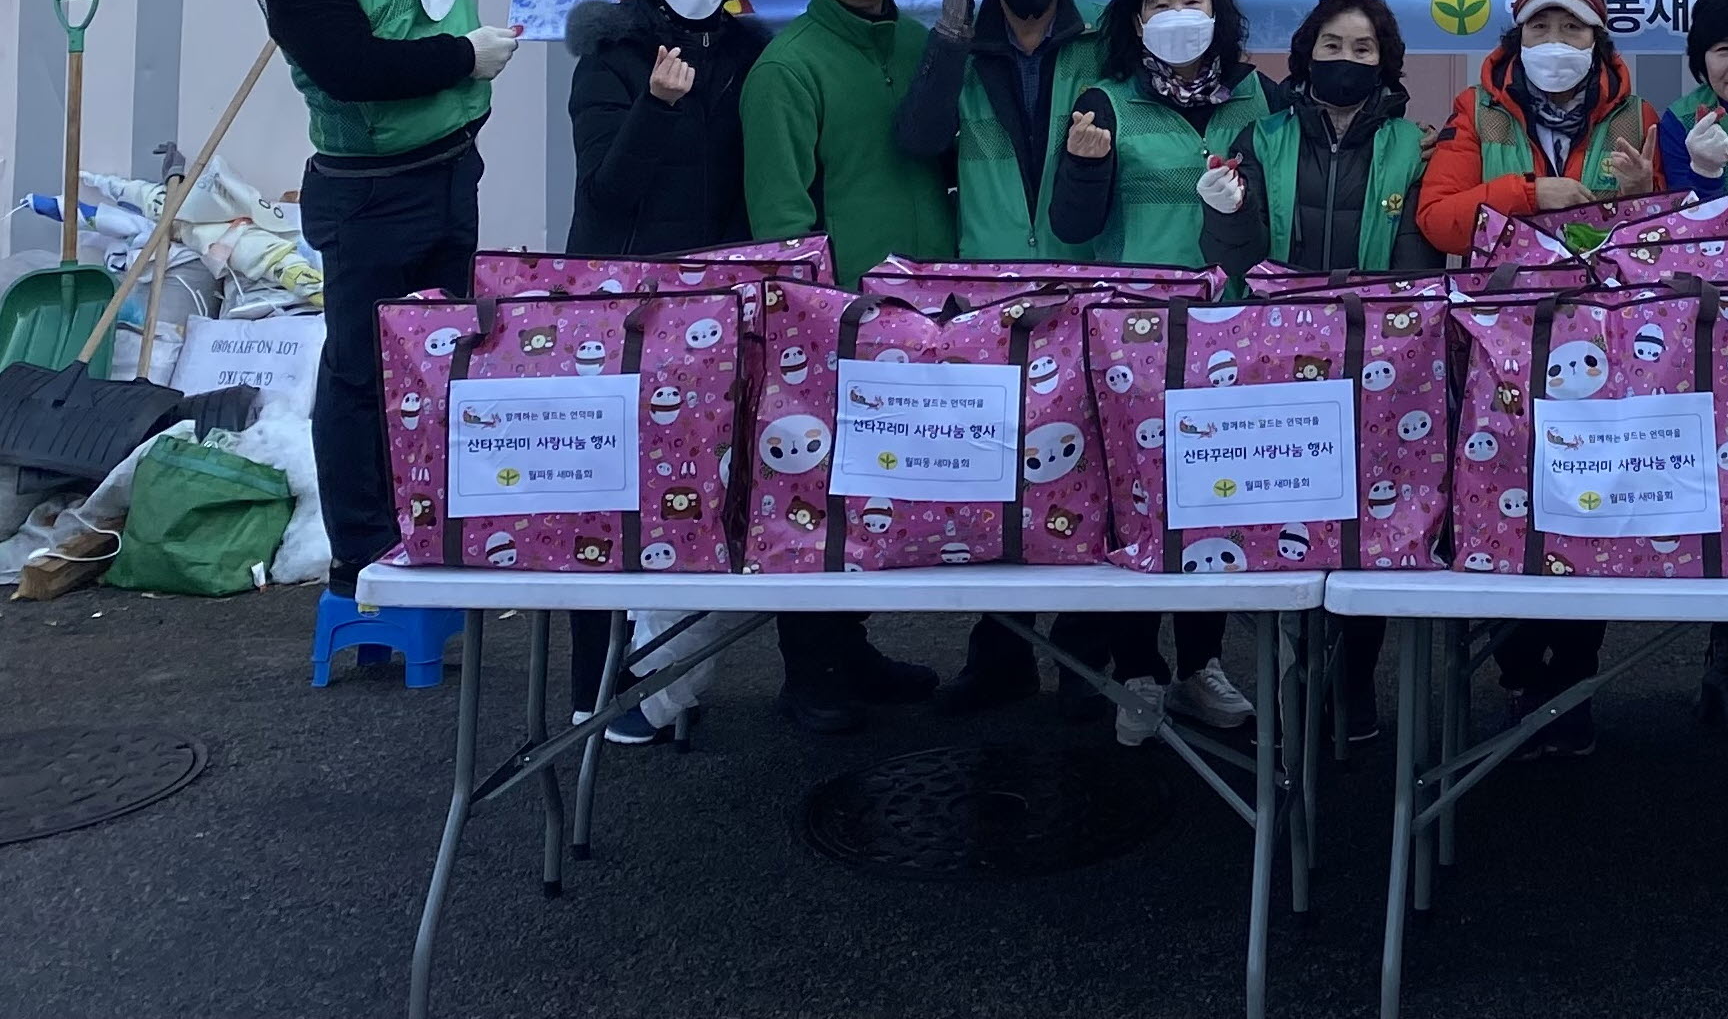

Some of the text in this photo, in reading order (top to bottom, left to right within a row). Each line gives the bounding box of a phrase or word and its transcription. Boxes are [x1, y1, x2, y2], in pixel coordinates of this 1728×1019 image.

[853, 419, 996, 439] 산타꾸러미 사랑나눔 행사
[467, 435, 616, 453] 산타꾸러미 사랑나눔 행사
[1183, 442, 1334, 464] 산타꾸러미 사랑나눔 행사
[933, 458, 970, 469] 새마을회
[1551, 454, 1695, 474] 산타꾸러미 사랑나눔 행사
[556, 469, 593, 480] 새마을회
[1273, 478, 1310, 489] 새마을회
[1639, 490, 1673, 502] 새마을회
